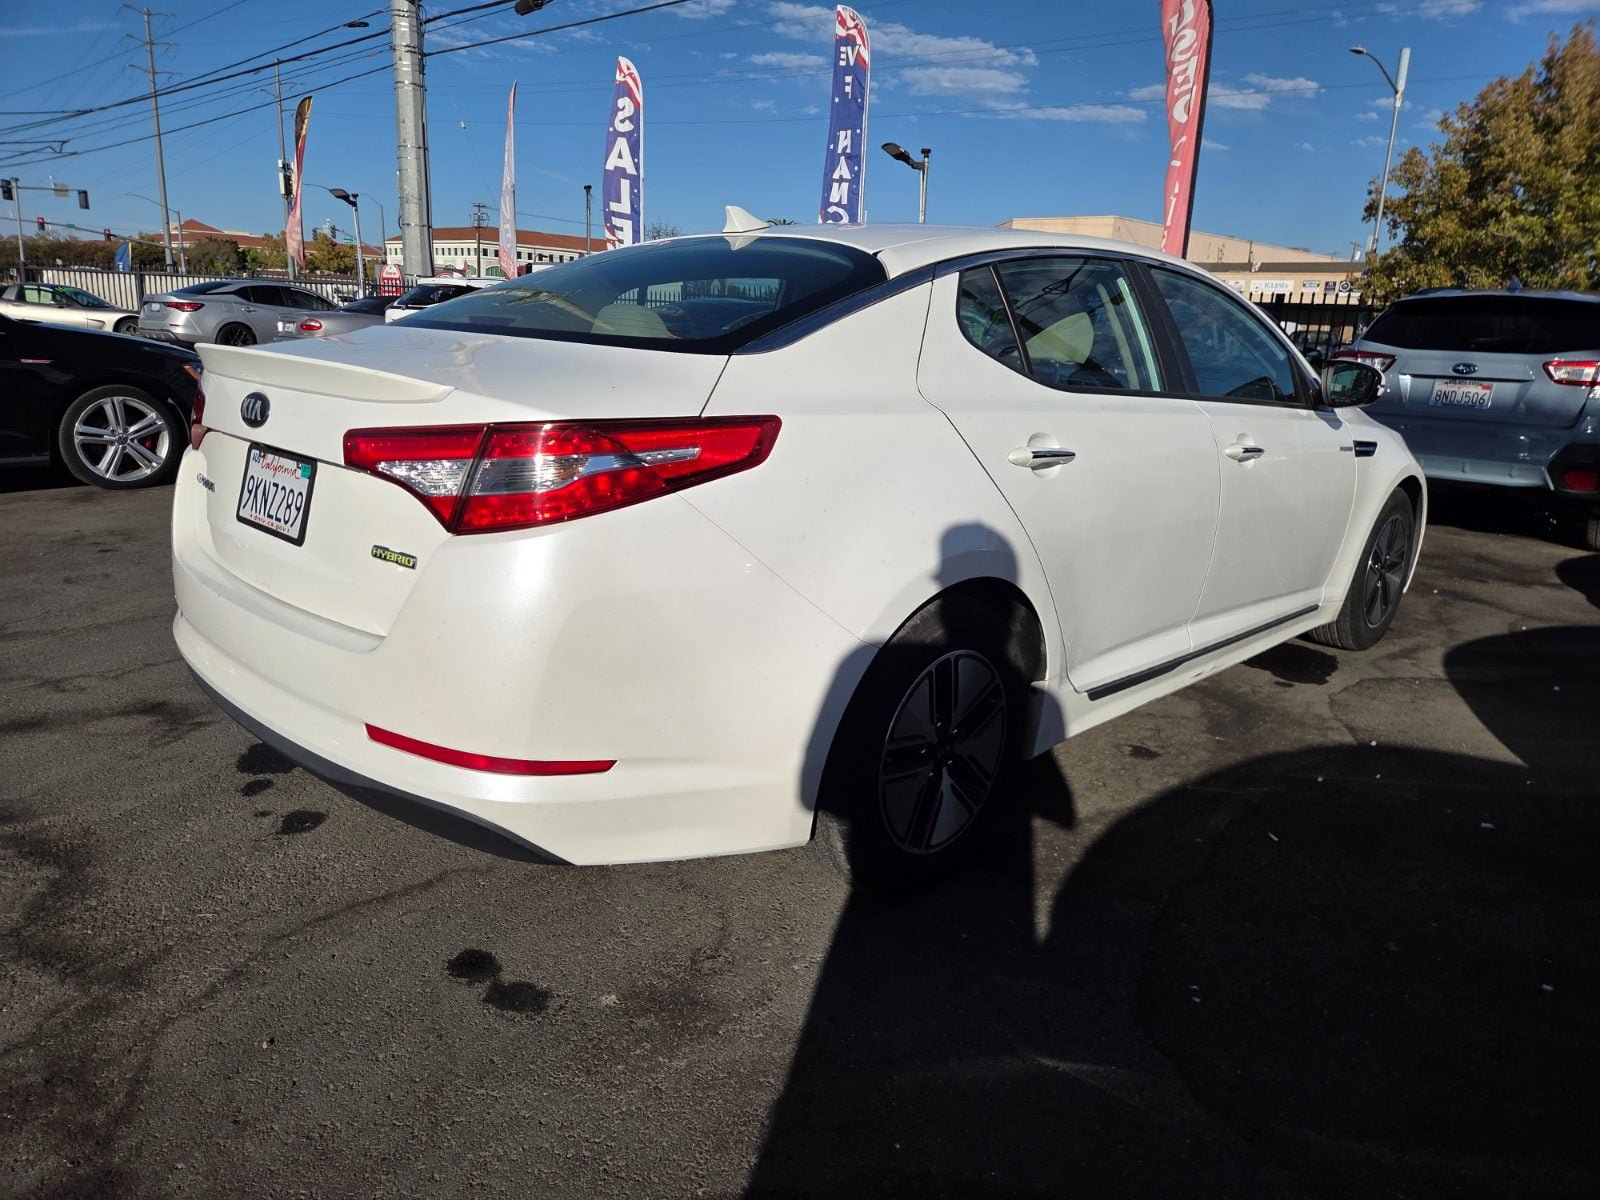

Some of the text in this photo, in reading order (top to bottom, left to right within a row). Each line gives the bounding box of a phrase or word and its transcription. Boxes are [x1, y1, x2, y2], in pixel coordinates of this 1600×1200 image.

[242, 397, 262, 421] KIA
[1434, 389, 1487, 405] 8NDJ506
[261, 452, 300, 479] California
[242, 474, 304, 528] 9KNZ289
[372, 547, 414, 567] HYBRID
